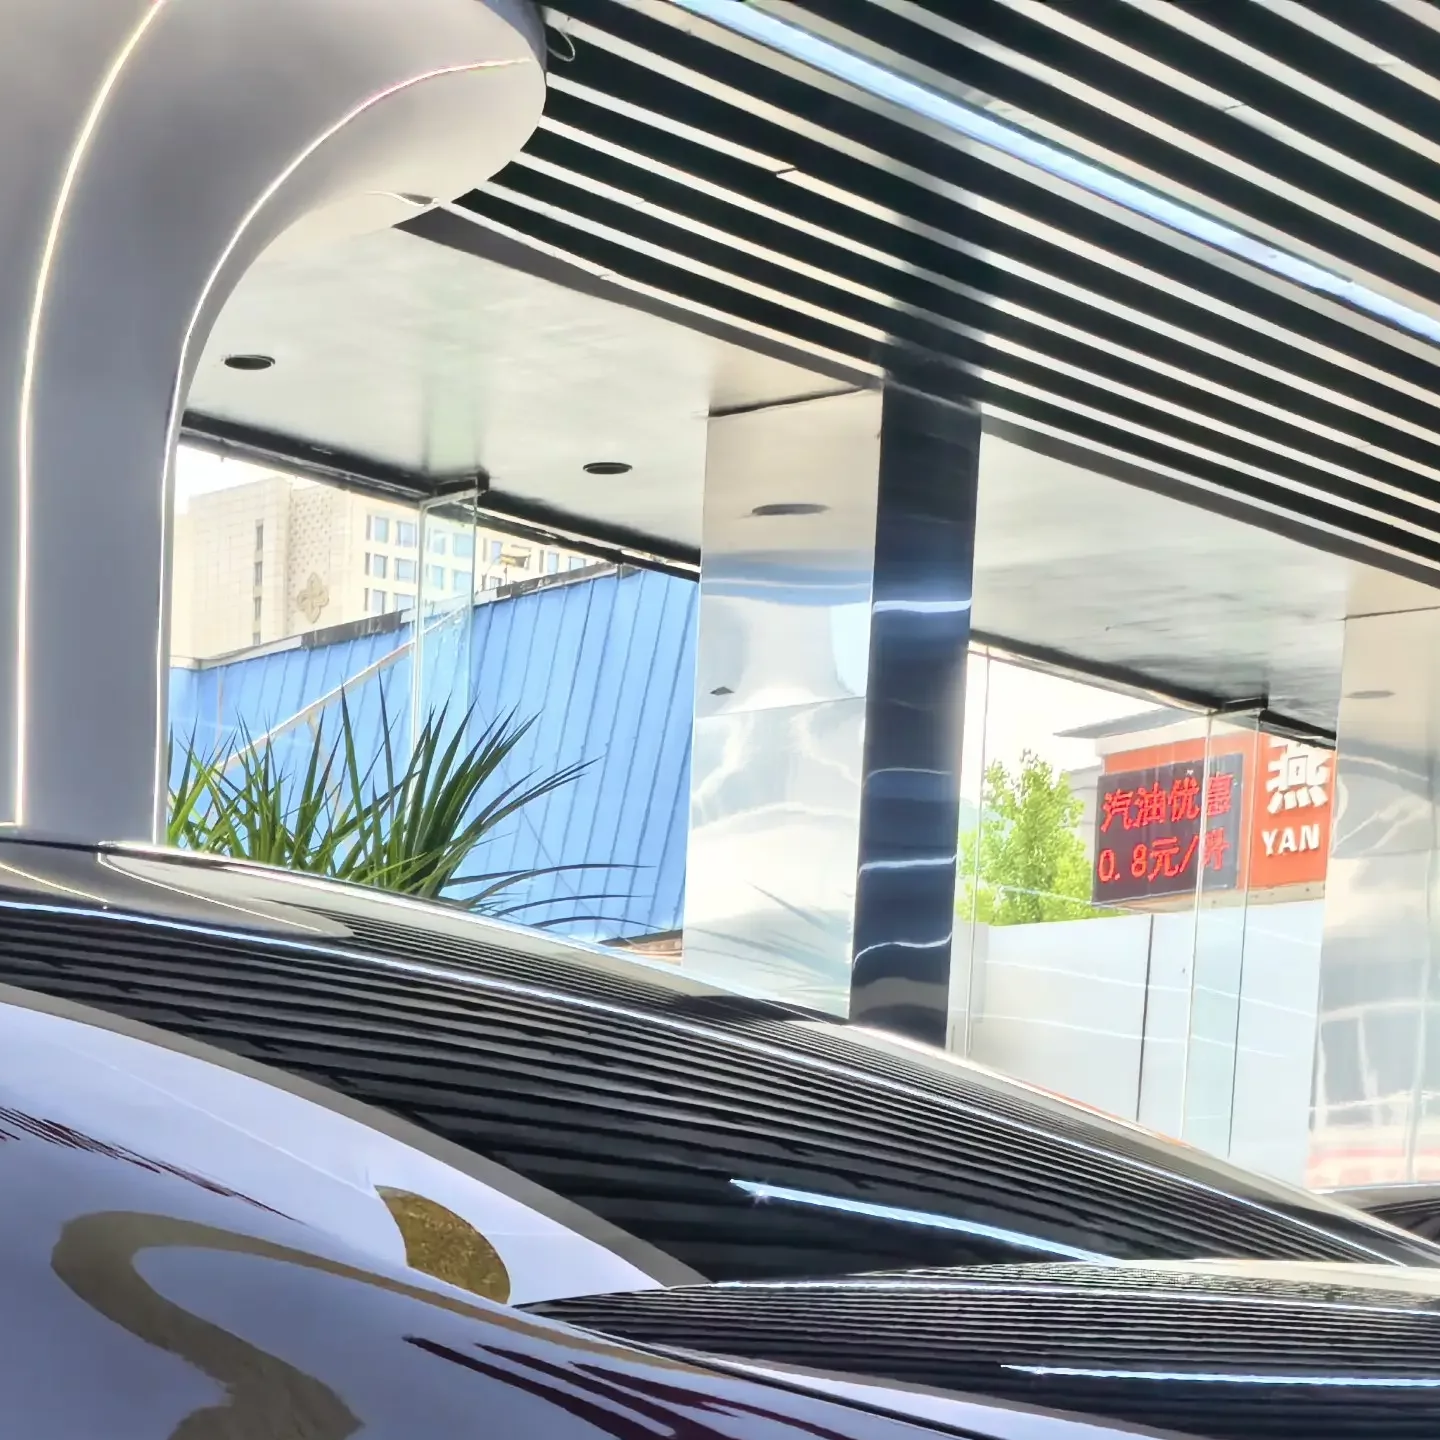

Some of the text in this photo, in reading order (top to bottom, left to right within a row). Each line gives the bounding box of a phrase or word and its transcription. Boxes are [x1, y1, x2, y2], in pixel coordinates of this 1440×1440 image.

[1101, 772, 1233, 832] 汽油优惠
[1265, 737, 1332, 814] 燕
[1261, 823, 1321, 857] YAN
